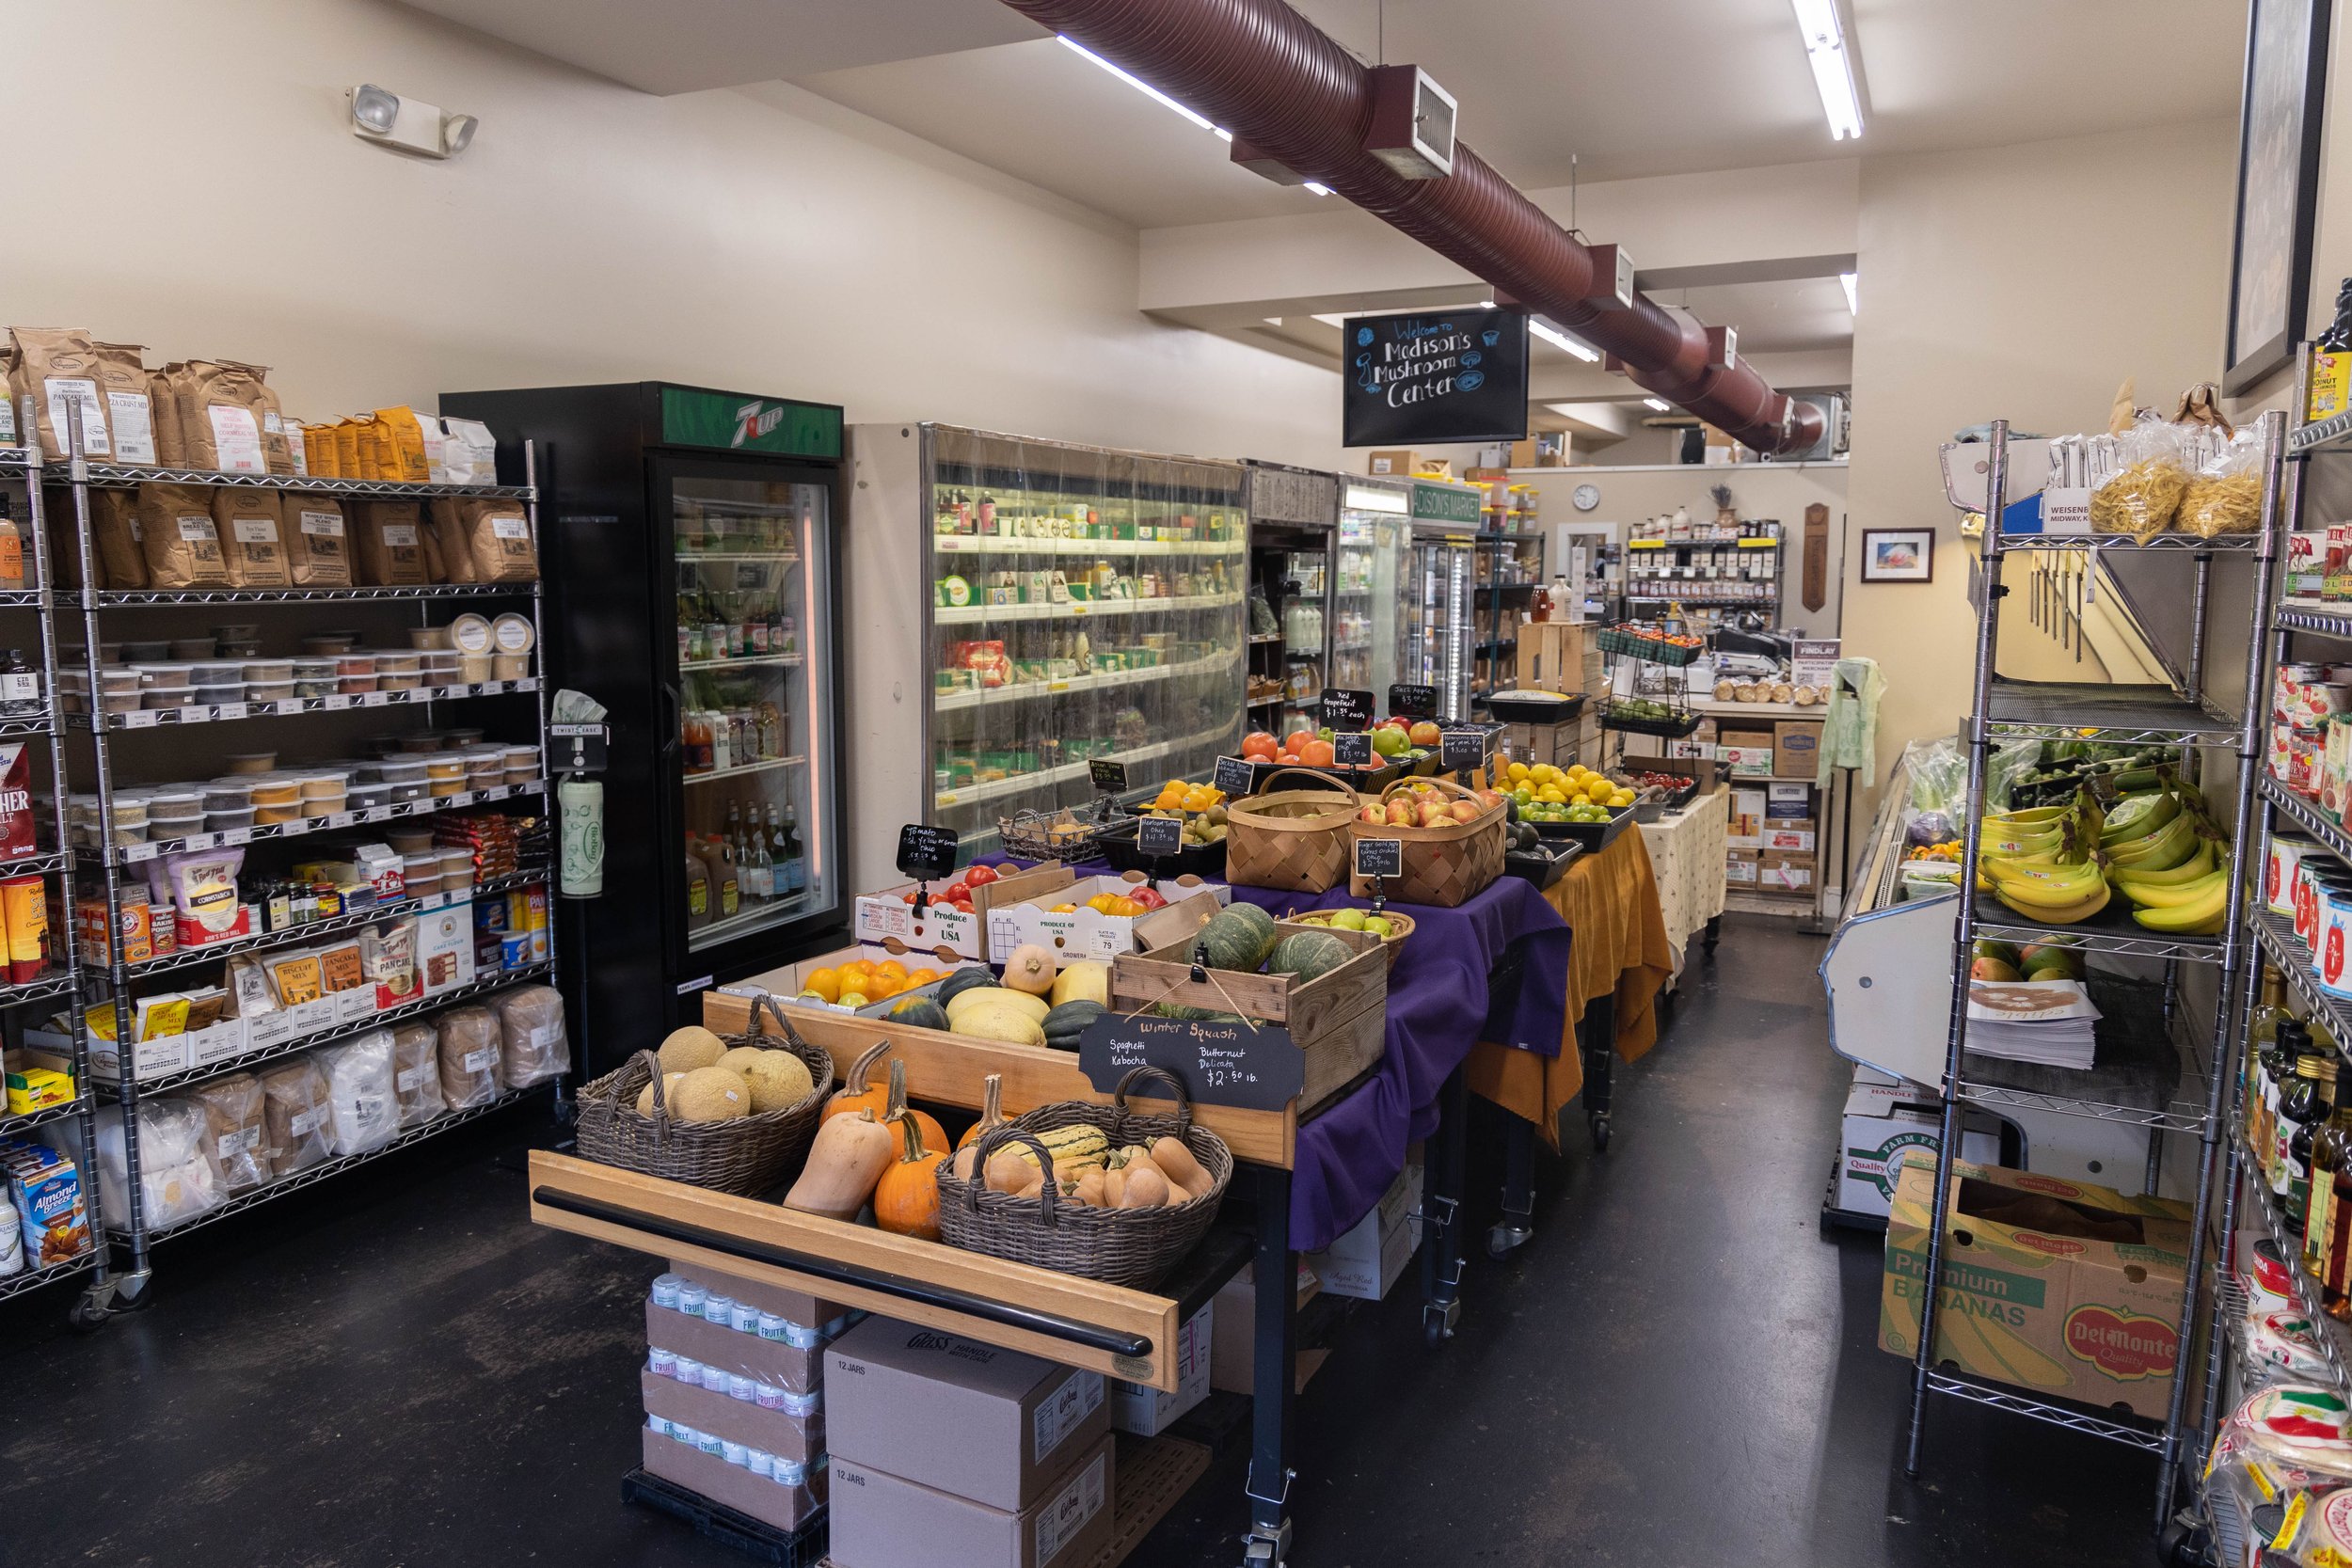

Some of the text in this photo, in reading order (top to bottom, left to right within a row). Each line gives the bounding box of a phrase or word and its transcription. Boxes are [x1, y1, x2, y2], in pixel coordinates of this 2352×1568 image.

[1394, 320, 1438, 340] Welcome
[1384, 332, 1471, 362] Madison's
[1374, 356, 1456, 384] Mushroom
[1387, 377, 1456, 408] Center
[1450, 495, 1479, 517] MARKET
[1324, 698, 1357, 707] Grapefruit
[1348, 711, 1365, 720] each
[589, 826, 598, 860] BioBag
[198, 891, 231, 904] CORNSTARCH
[934, 910, 967, 923] Produce
[204, 933, 219, 942] BOB'S
[941, 929, 961, 942] USA
[325, 953, 357, 967] PANCAKE
[379, 957, 411, 973] PANCAKE
[282, 963, 313, 975] BISCUIT
[292, 972, 307, 980] MIX
[1140, 1022, 1237, 1042] Winter Squash
[1110, 1038, 1145, 1054] Spaghetti
[1199, 1046, 1247, 1058] Butternut
[1111, 1055, 1147, 1066] Kabocha
[1199, 1058, 1234, 1069] Delicata
[1870, 1088, 1913, 1099] HANDLE
[1883, 1134, 1939, 1154] FARM FR
[1851, 1160, 1885, 1174] Quality
[34, 1181, 76, 1212] Almond
[43, 1194, 72, 1214] Breeze
[49, 1215, 72, 1227] Chocolate
[1354, 1274, 1373, 1285] Red
[906, 1332, 999, 1360] Glass HANDLE
[2074, 1321, 2177, 1358] Del Monte
[948, 1349, 968, 1361] WITH
[2100, 1346, 2145, 1369] Quality
[837, 1360, 866, 1376] 12 JARS
[836, 1468, 866, 1487] 12 JARS
